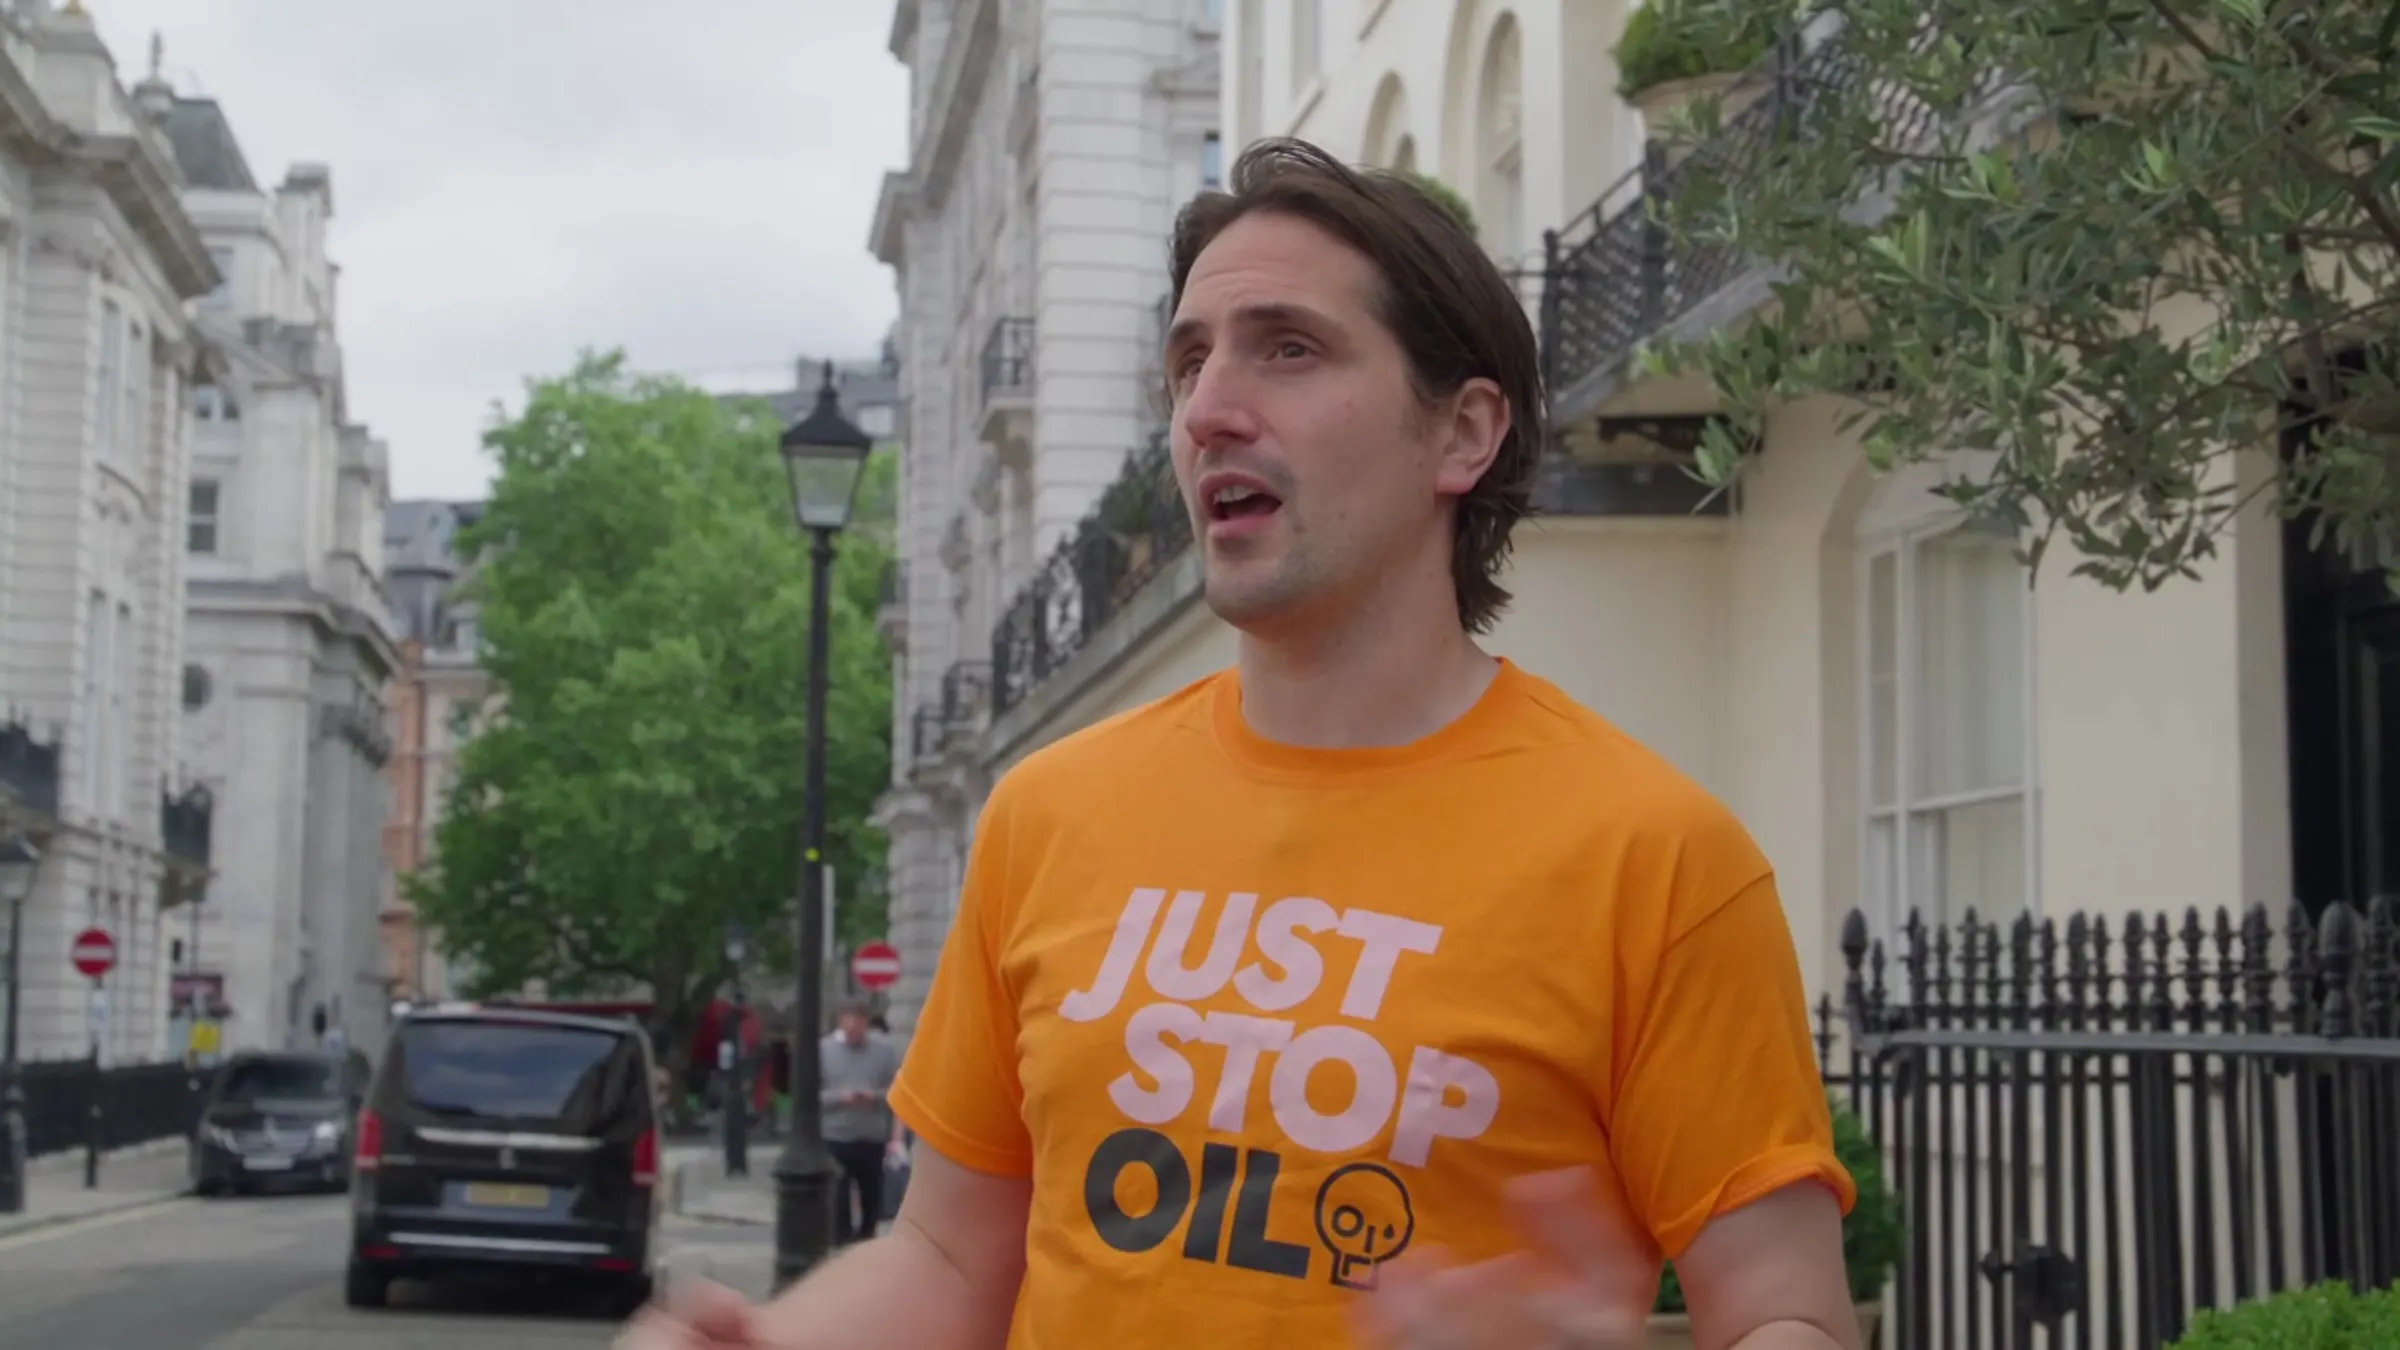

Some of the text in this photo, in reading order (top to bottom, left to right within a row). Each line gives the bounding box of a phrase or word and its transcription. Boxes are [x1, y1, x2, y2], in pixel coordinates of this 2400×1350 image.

[1058, 888, 1443, 1021] JUST
[1108, 1003, 1499, 1168] STOP
[1084, 1128, 1310, 1279] OIL
